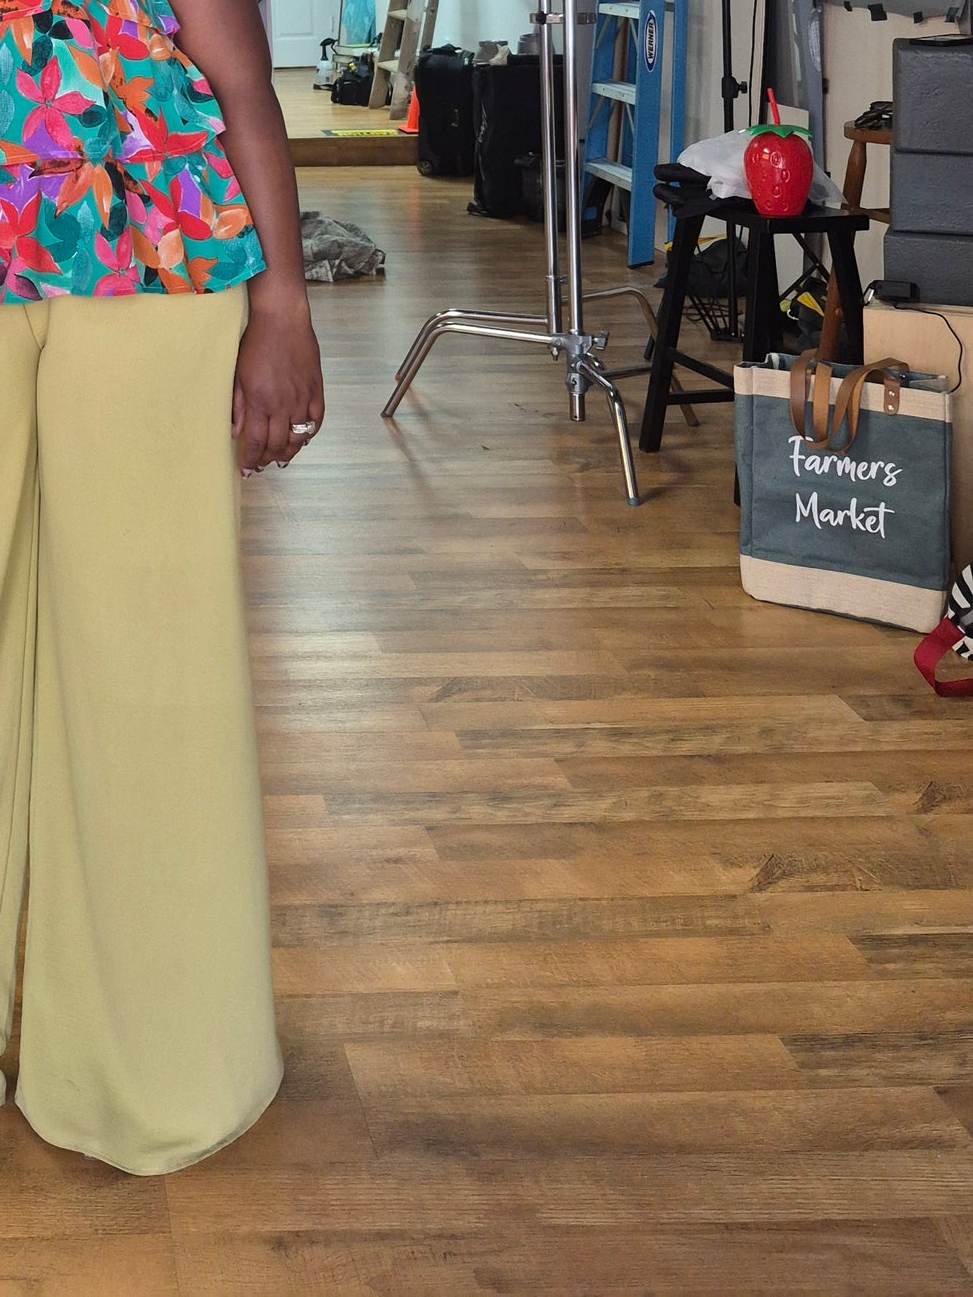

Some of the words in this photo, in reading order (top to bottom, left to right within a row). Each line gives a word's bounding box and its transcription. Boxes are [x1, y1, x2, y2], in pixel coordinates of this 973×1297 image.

[647, 22, 655, 59] WERNER
[788, 435, 903, 487] Farmers
[795, 491, 895, 539] Market
